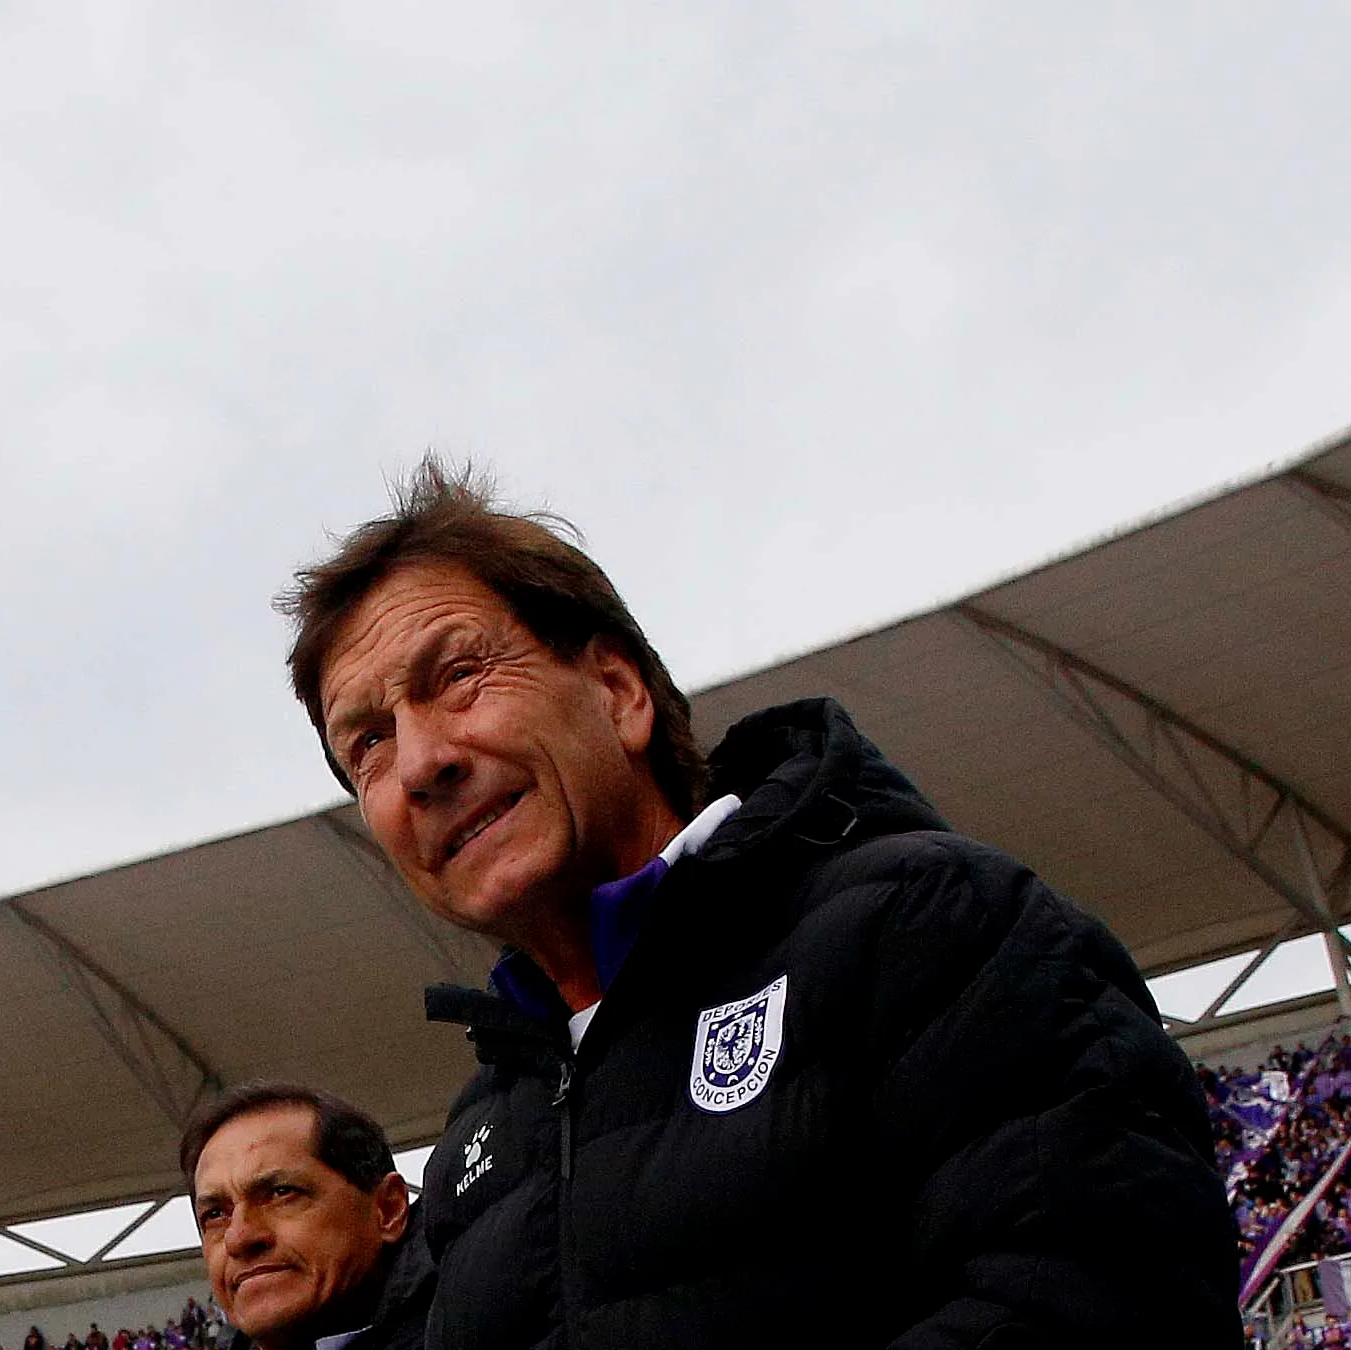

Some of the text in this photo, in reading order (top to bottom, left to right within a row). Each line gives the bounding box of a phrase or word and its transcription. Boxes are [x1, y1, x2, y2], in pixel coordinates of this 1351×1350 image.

[702, 981, 783, 1022] DEPORTES
[692, 1049, 777, 1104] CONCEPCION
[455, 1153, 494, 1197] KELME
